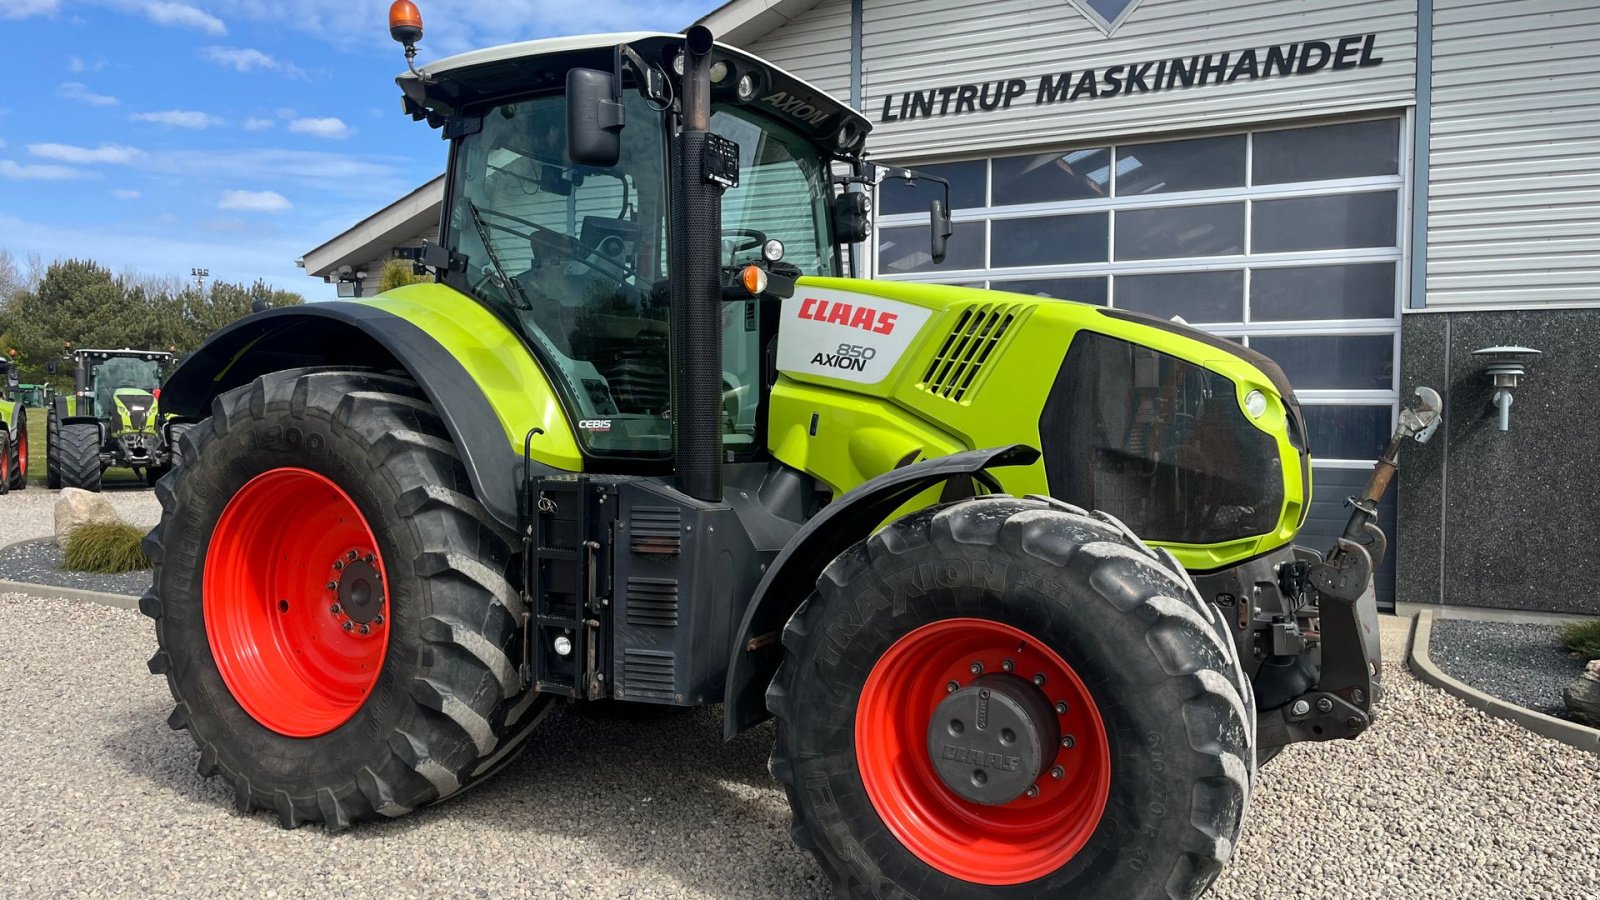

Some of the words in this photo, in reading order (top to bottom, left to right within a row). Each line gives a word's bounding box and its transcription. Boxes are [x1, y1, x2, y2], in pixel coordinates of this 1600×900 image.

[881, 78, 1026, 122] LINTRUP
[1035, 34, 1384, 105] MASKINHANDEL
[760, 91, 830, 126] AXION
[797, 297, 899, 336] CLAAS
[810, 352, 867, 372] AXION
[836, 343, 877, 361] 850
[578, 419, 612, 429] CEBIS
[814, 558, 1008, 666] TRAXION
[941, 744, 1020, 772] CLAAS
